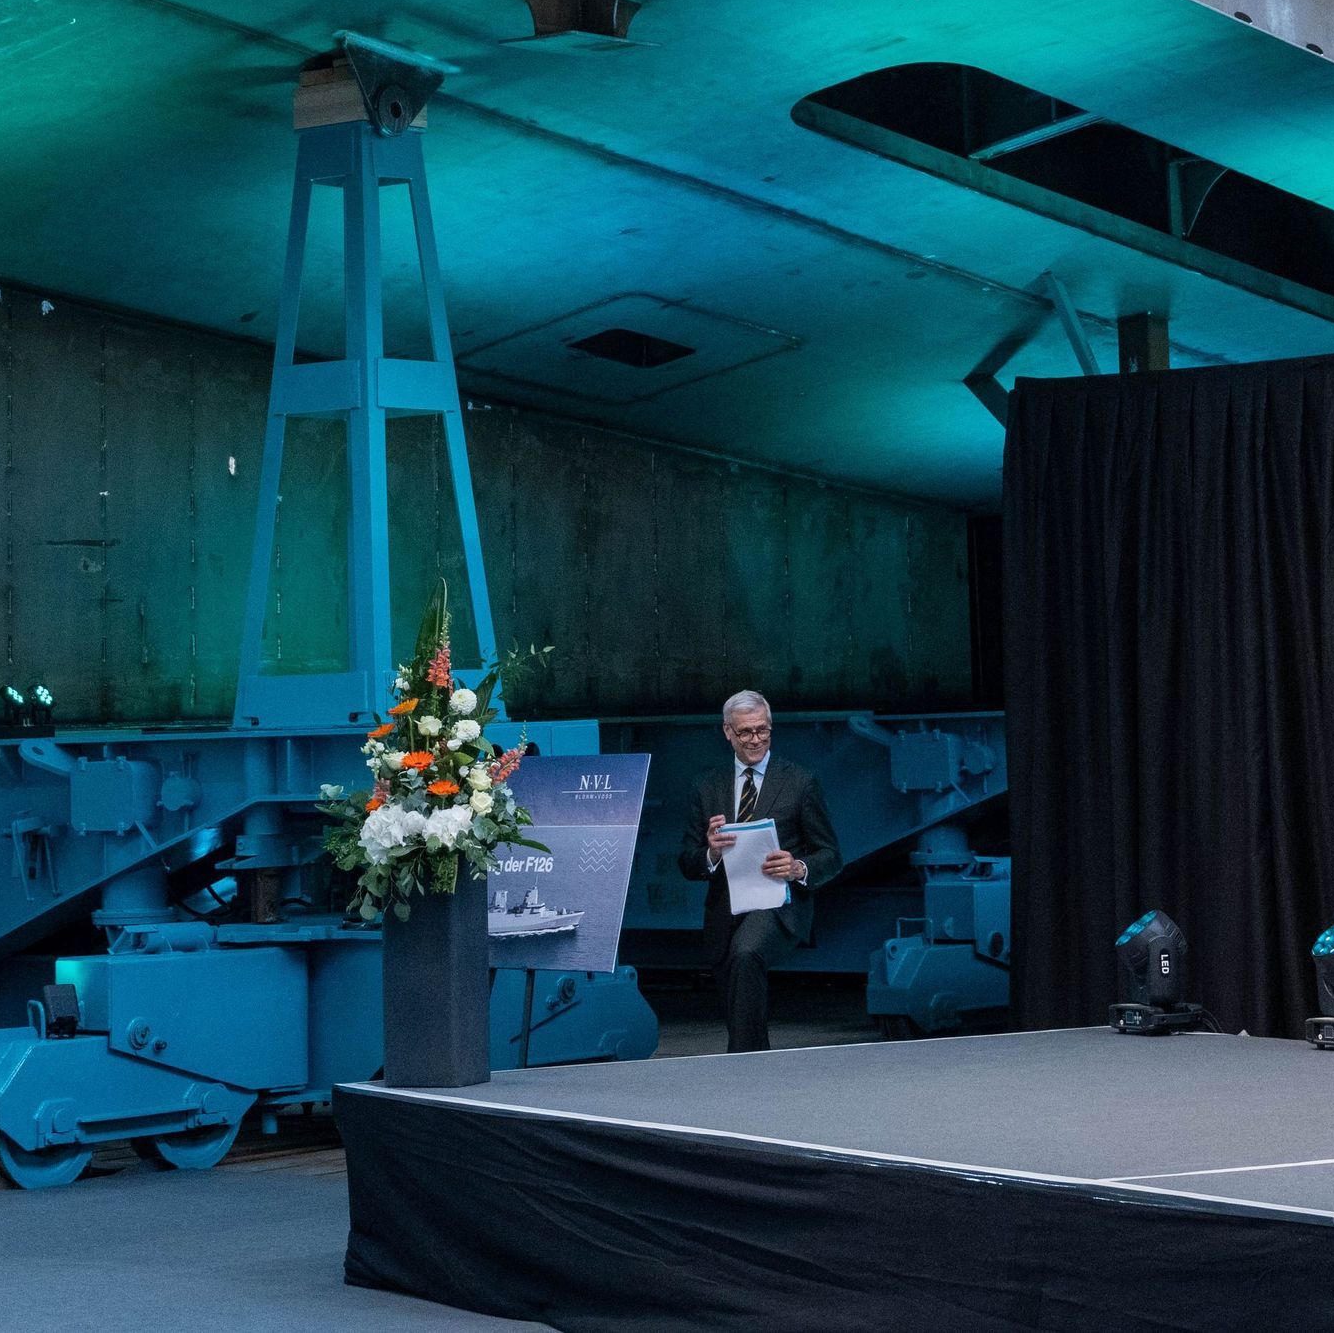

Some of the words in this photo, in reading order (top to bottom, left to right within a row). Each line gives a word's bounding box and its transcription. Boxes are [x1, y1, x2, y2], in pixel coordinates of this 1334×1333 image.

[504, 856, 525, 873] der
[525, 856, 554, 873] F126
[1160, 954, 1170, 975] LED
